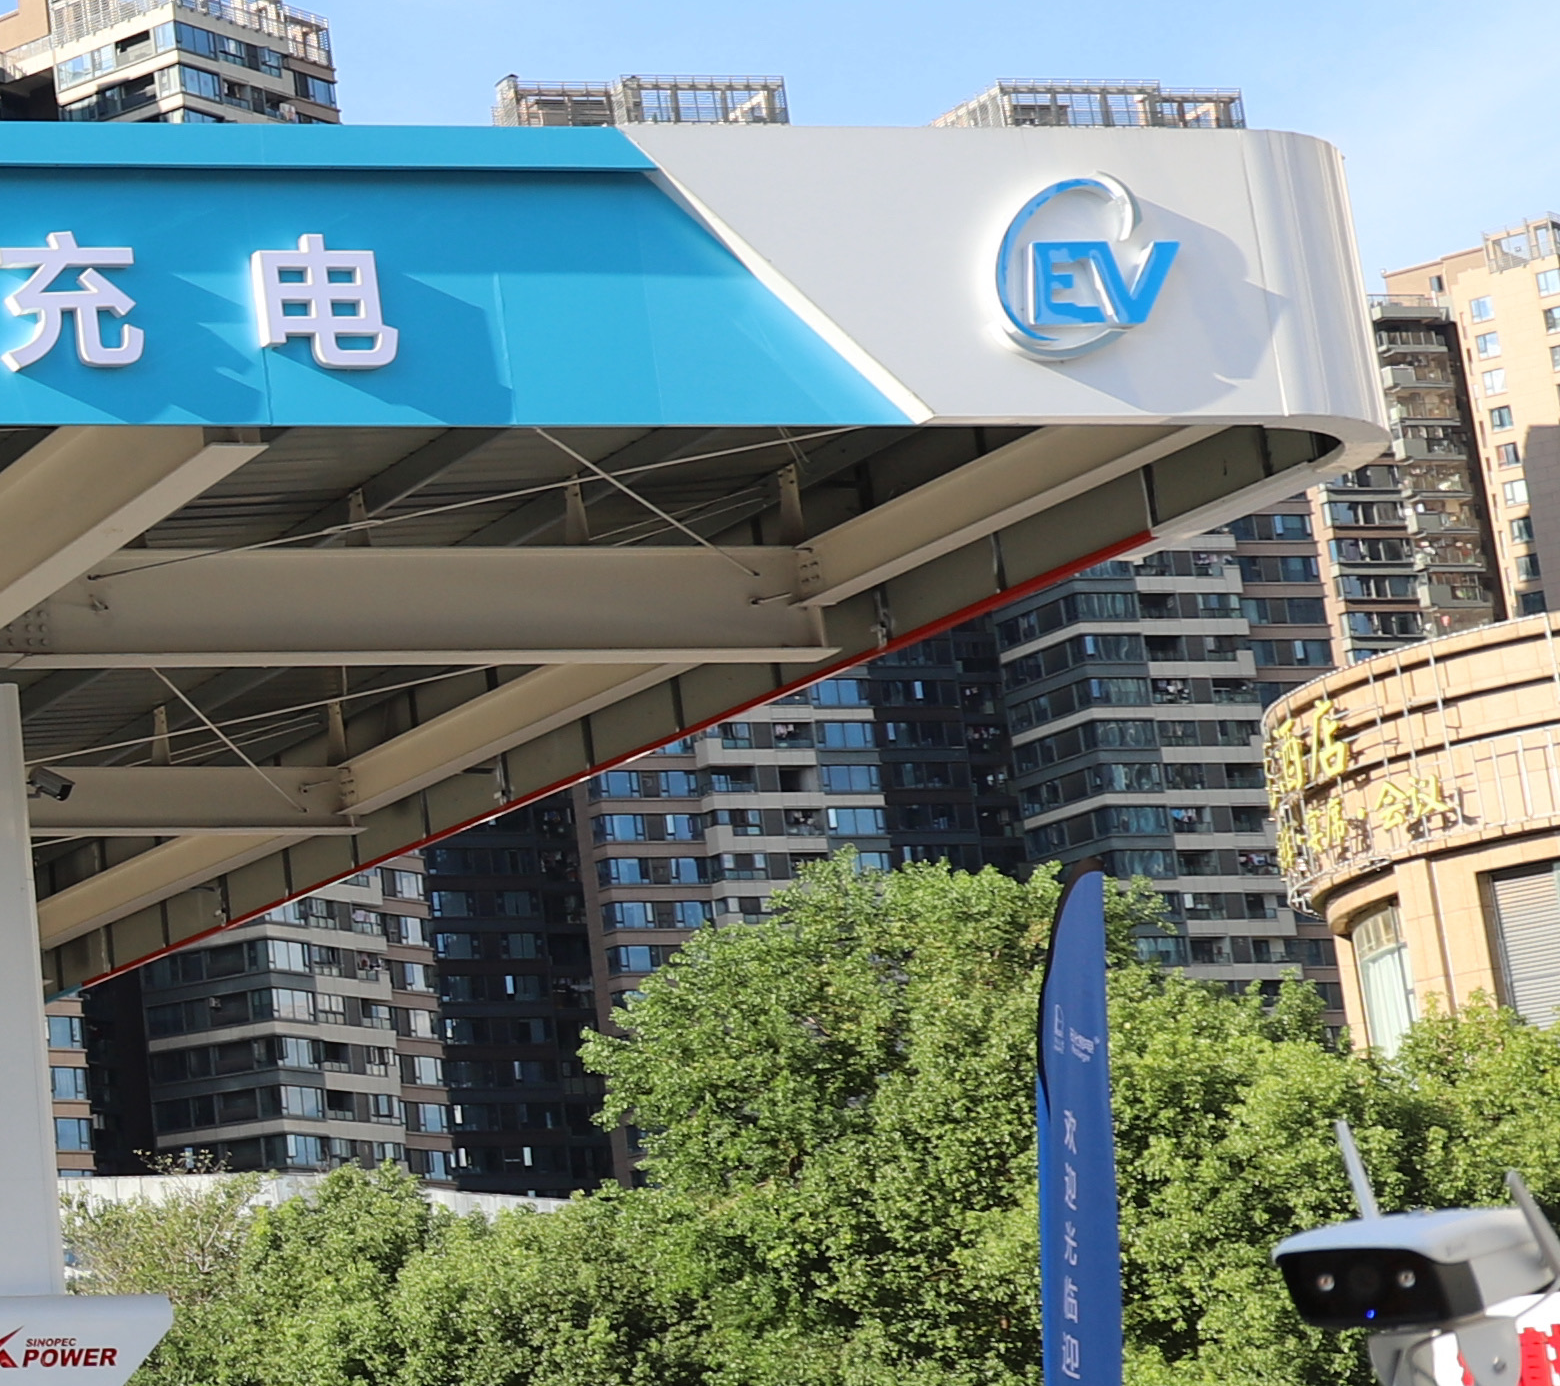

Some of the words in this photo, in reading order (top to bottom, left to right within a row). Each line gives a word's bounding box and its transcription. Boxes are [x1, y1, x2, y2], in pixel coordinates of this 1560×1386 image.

[1026, 239, 1181, 329] EV
[26, 1337, 77, 1347] SINOPEC
[22, 1347, 118, 1368] POWER
